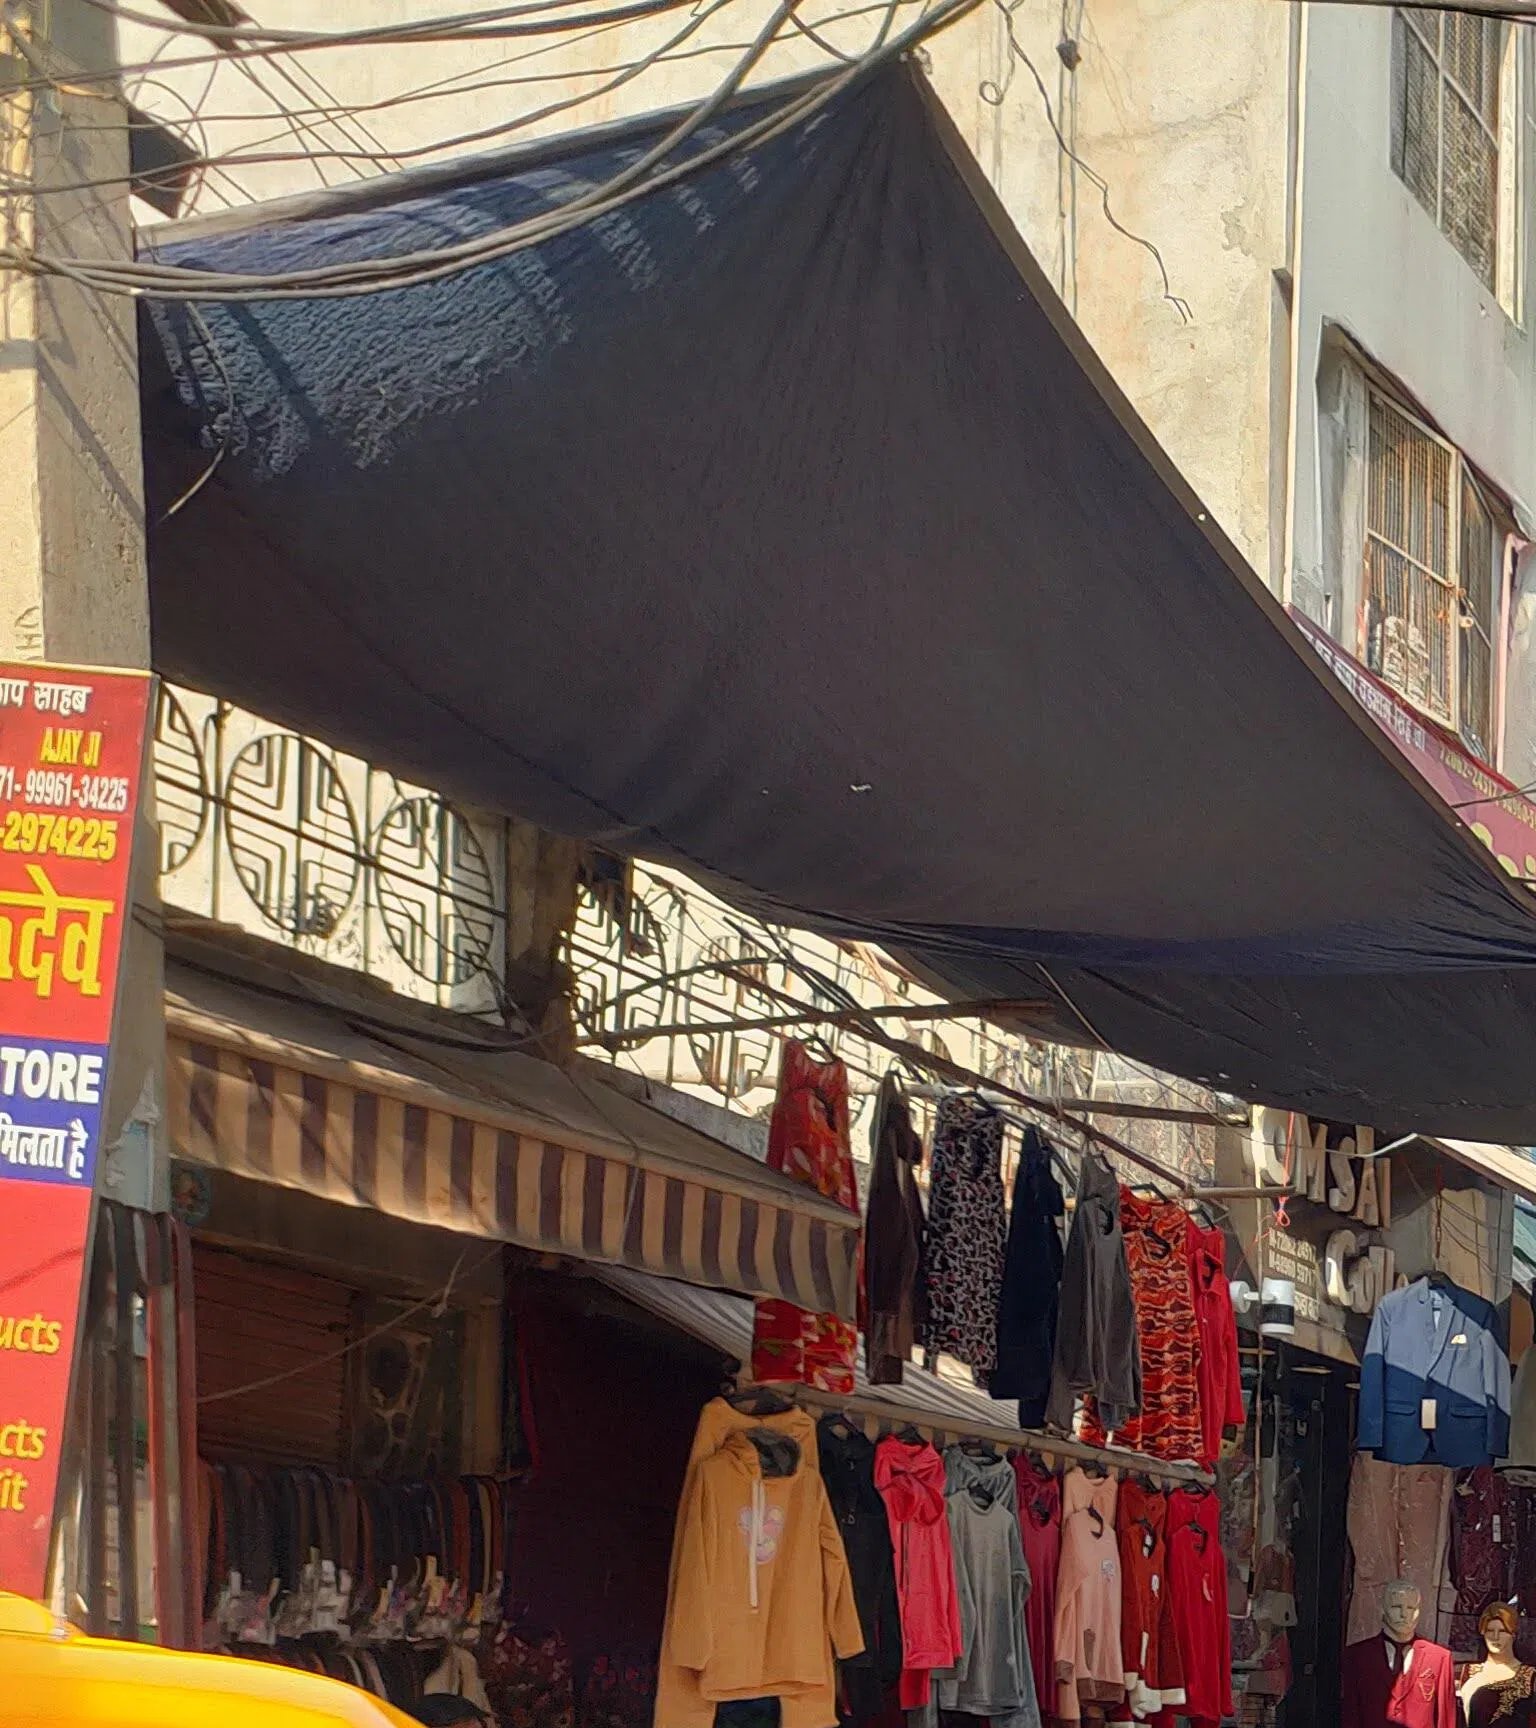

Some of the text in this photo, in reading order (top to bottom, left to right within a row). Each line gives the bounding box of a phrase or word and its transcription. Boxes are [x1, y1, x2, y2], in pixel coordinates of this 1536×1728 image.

[34, 681, 92, 713] साहब
[41, 727, 101, 767] AJAY JI
[25, 776, 128, 811] 99961-34225
[0, 812, 117, 860] -2974225
[2, 1047, 103, 1104] TORE
[66, 1118, 88, 1179] है
[1328, 1125, 1391, 1231] SAI
[0, 1313, 61, 1354] ucts
[0, 1419, 47, 1459] cts
